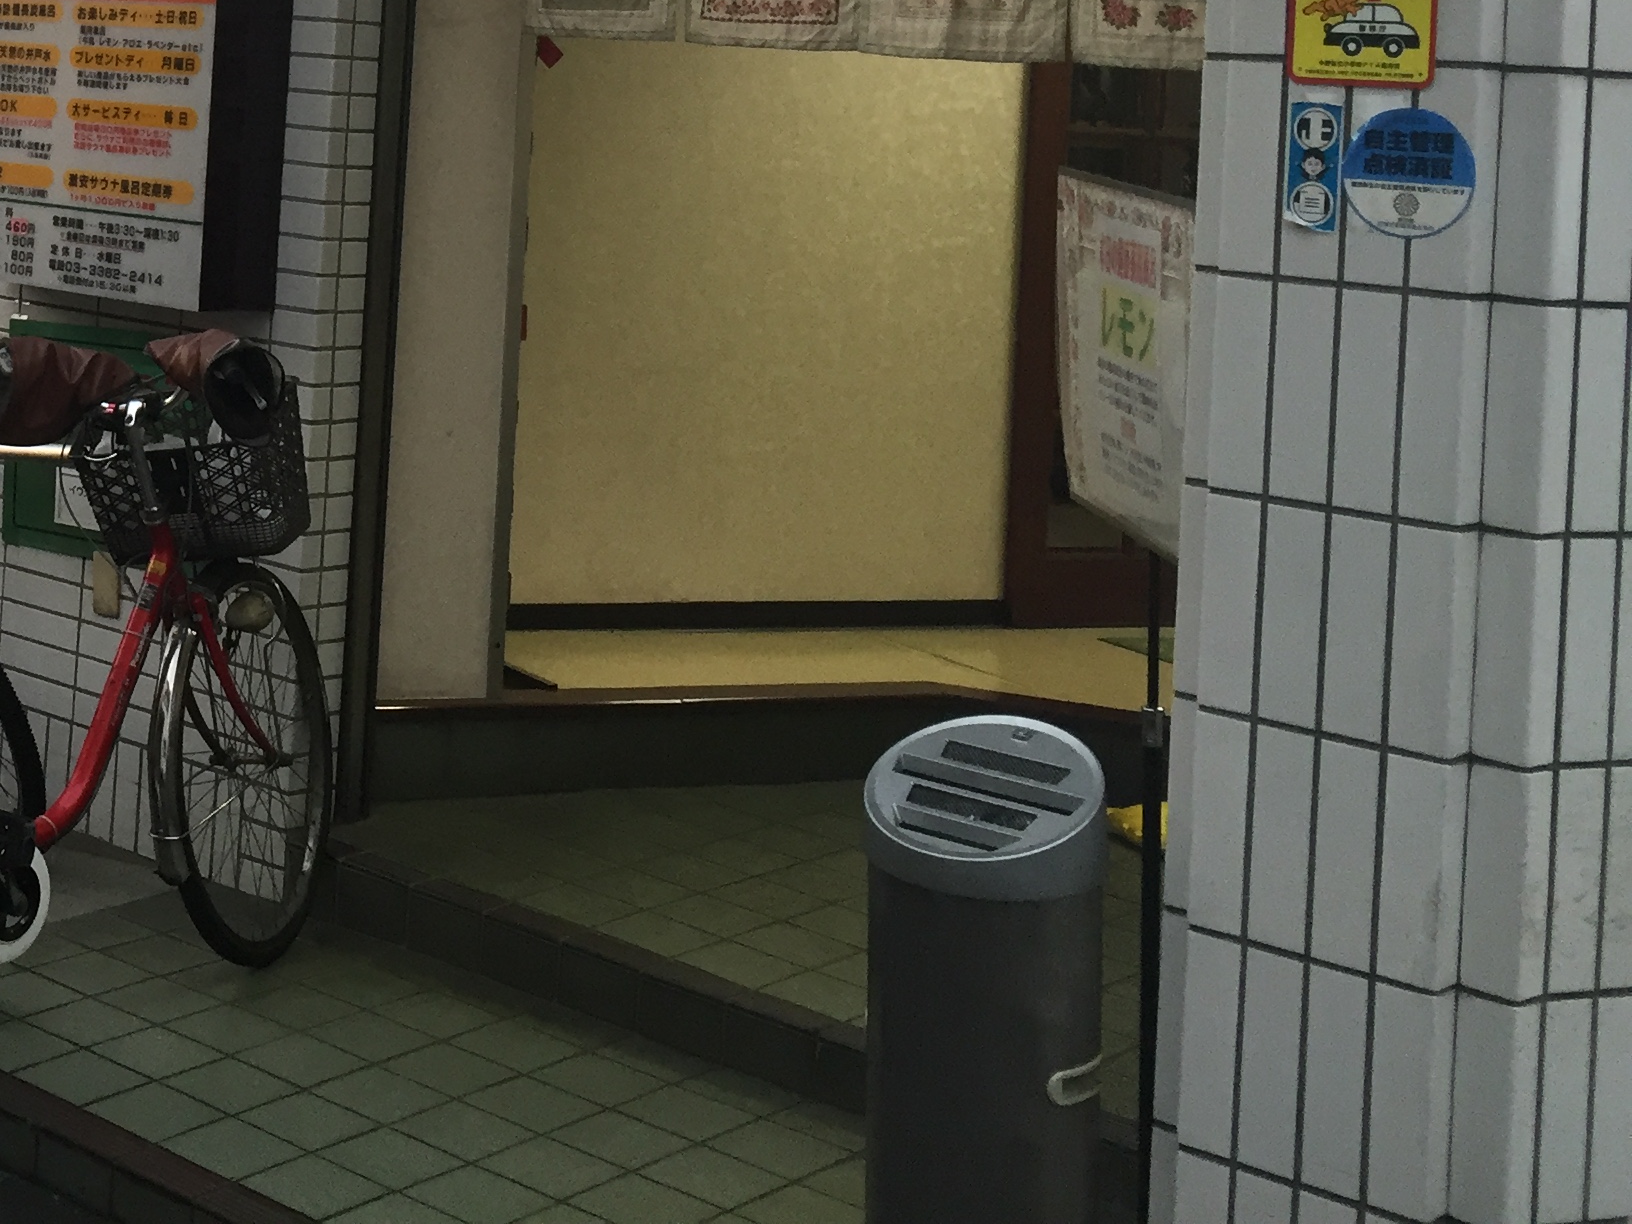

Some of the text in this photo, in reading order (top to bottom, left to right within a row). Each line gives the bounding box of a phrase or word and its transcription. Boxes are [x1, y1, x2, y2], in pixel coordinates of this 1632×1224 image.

[5, 220, 36, 234] 460円
[4, 261, 34, 277] 100円
[1101, 286, 1155, 362] レモン
